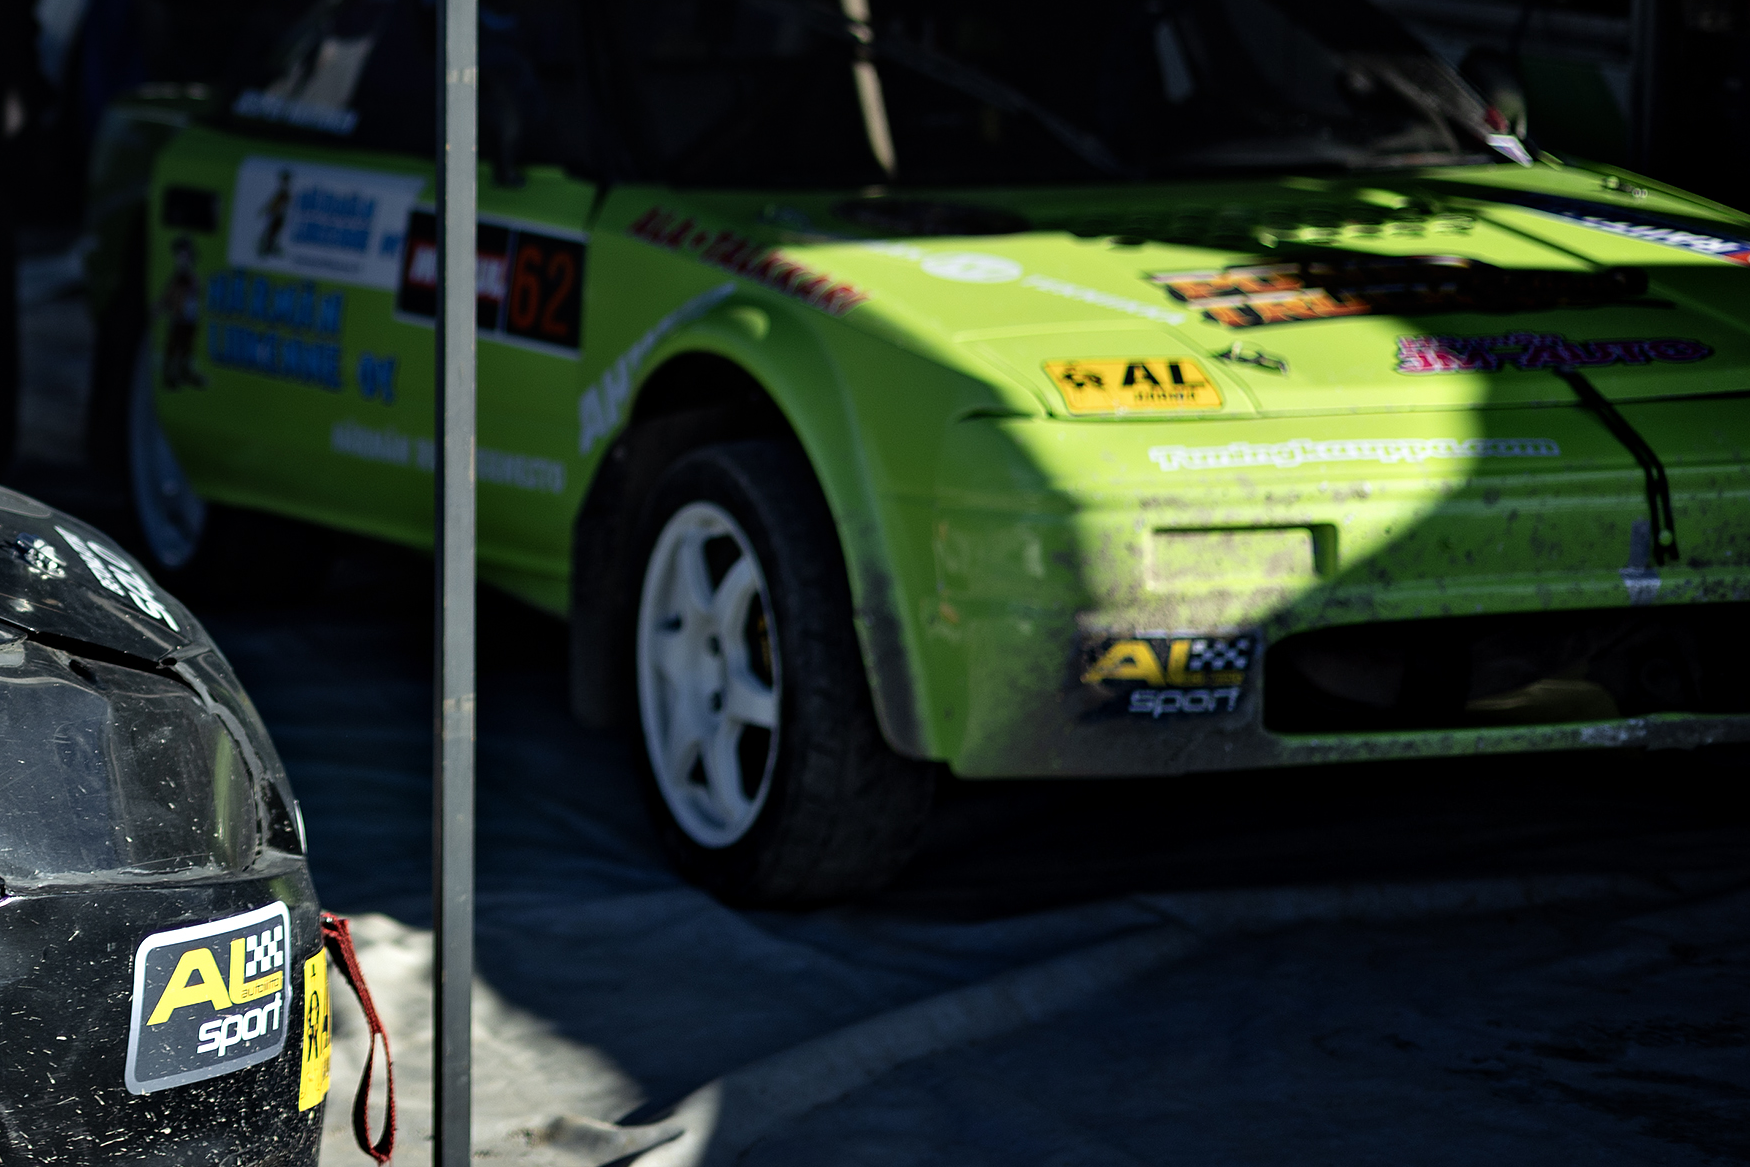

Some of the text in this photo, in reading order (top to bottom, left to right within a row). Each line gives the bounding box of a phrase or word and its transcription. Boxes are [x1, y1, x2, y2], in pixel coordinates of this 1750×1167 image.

[508, 241, 576, 338] 62
[1080, 639, 1246, 687] AL
[1128, 687, 1240, 718] sport
[146, 937, 283, 1026] AL
[196, 991, 283, 1056] sport
